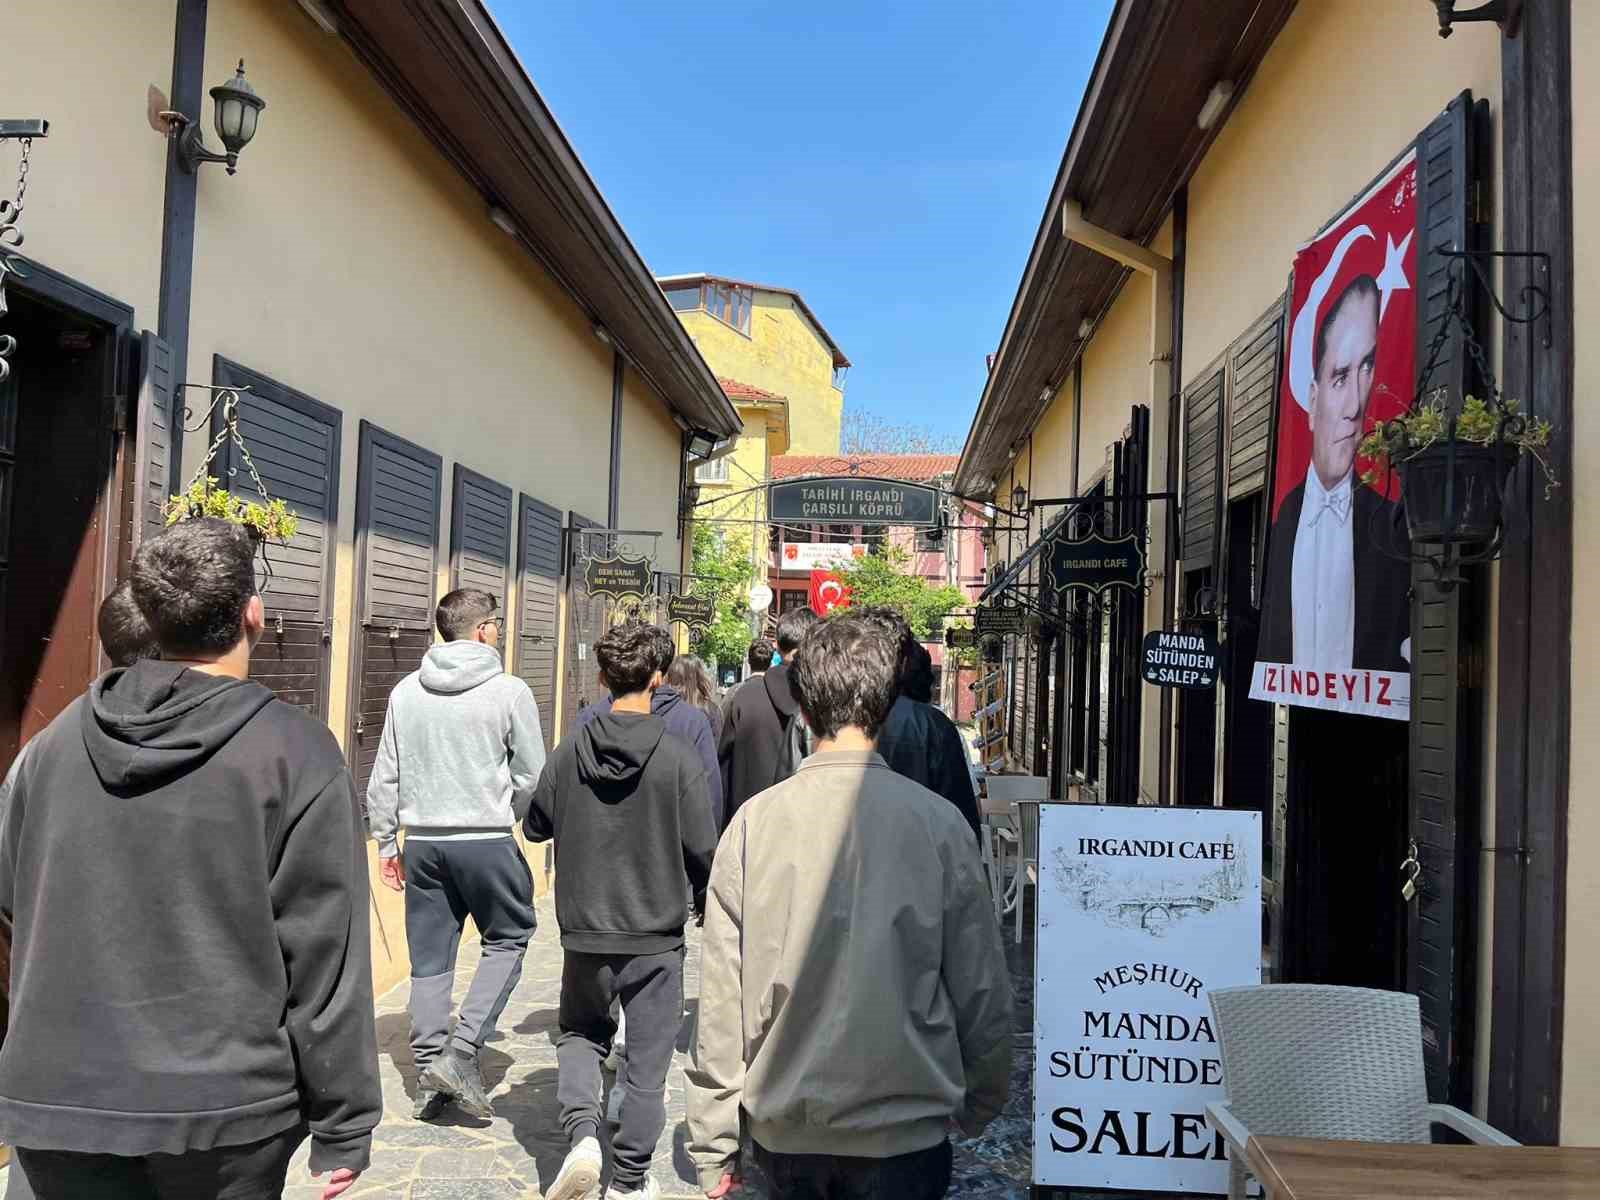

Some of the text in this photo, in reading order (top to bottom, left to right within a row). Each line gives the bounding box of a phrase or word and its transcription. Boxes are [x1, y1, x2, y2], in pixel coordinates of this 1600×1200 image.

[801, 486, 904, 502] TARİHİ IRGANDI
[803, 502, 903, 517] ÇARŞILI KÖPRÜ
[1063, 557, 1128, 569] IRGANDI CAFE
[1158, 633, 1205, 651] MANDA
[1146, 648, 1215, 670] SÜTÜNDEN
[1158, 669, 1199, 685] SALEP
[1079, 838, 1235, 860] IRGANDI CAFE
[1094, 963, 1203, 999] MEŞHUR
[1084, 1010, 1216, 1043] MANDA
[1049, 1046, 1224, 1086] SÜTÜNDE
